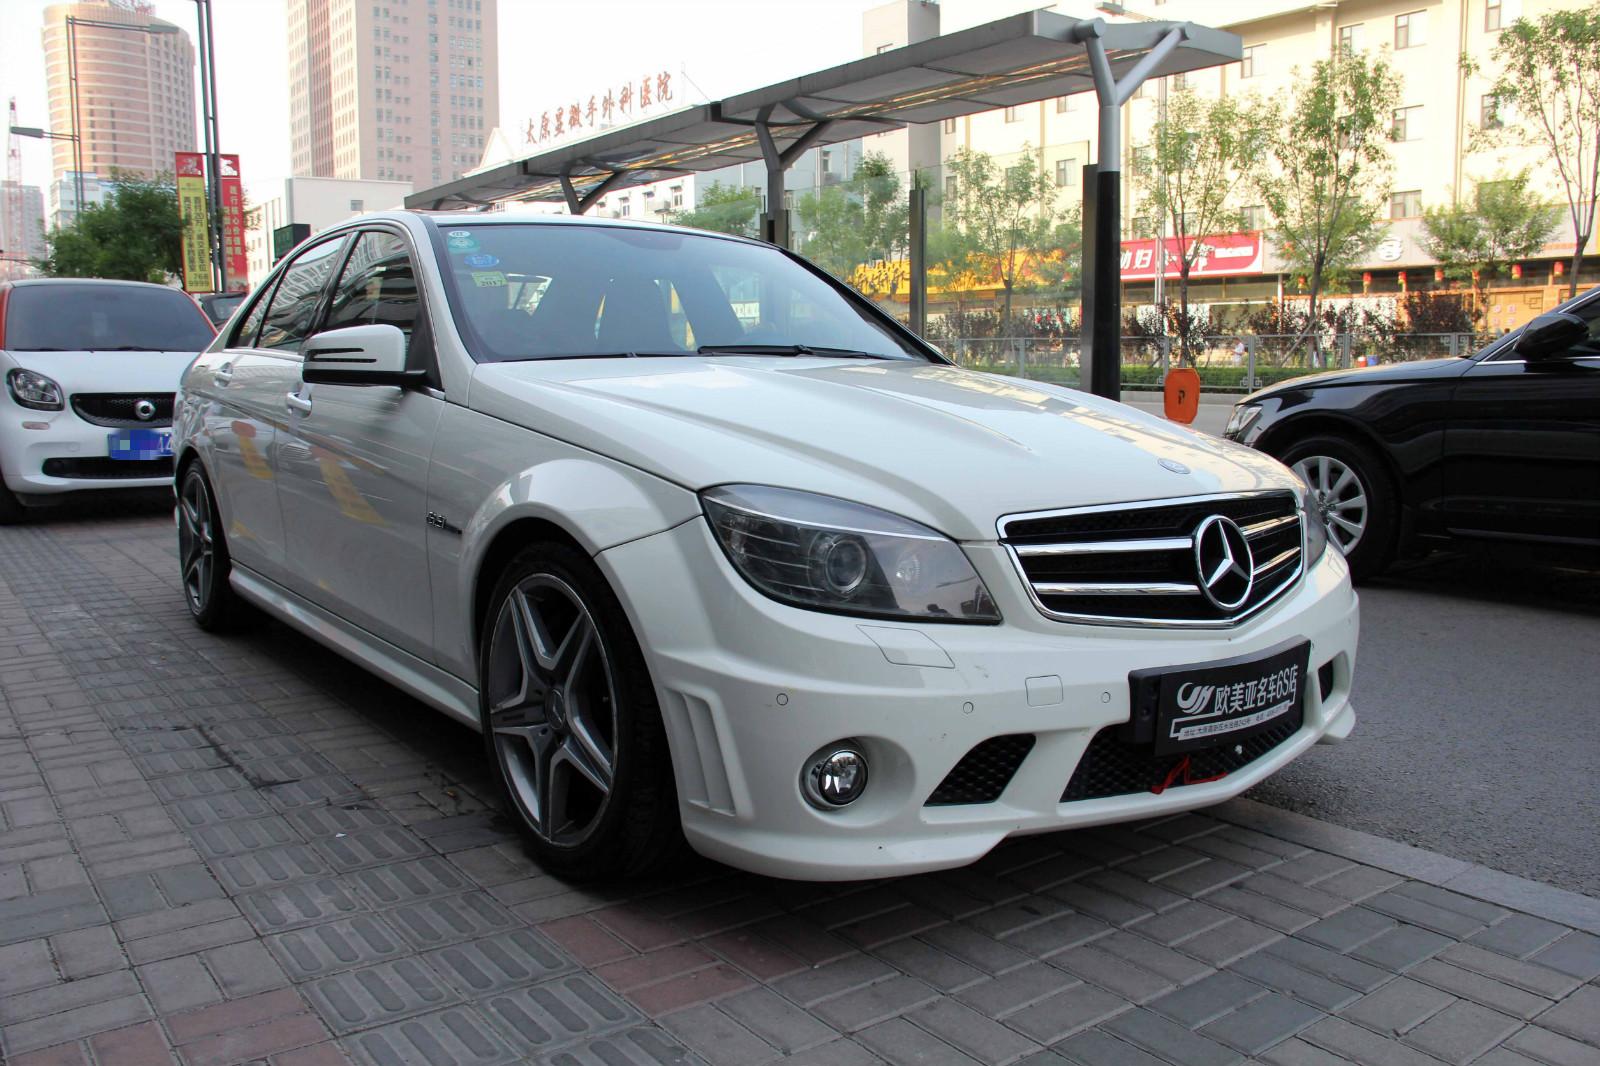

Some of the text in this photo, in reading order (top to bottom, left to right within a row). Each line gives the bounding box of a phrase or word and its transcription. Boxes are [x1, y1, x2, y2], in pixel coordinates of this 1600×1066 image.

[1215, 664, 1298, 714] 欧美亚名车6S店
